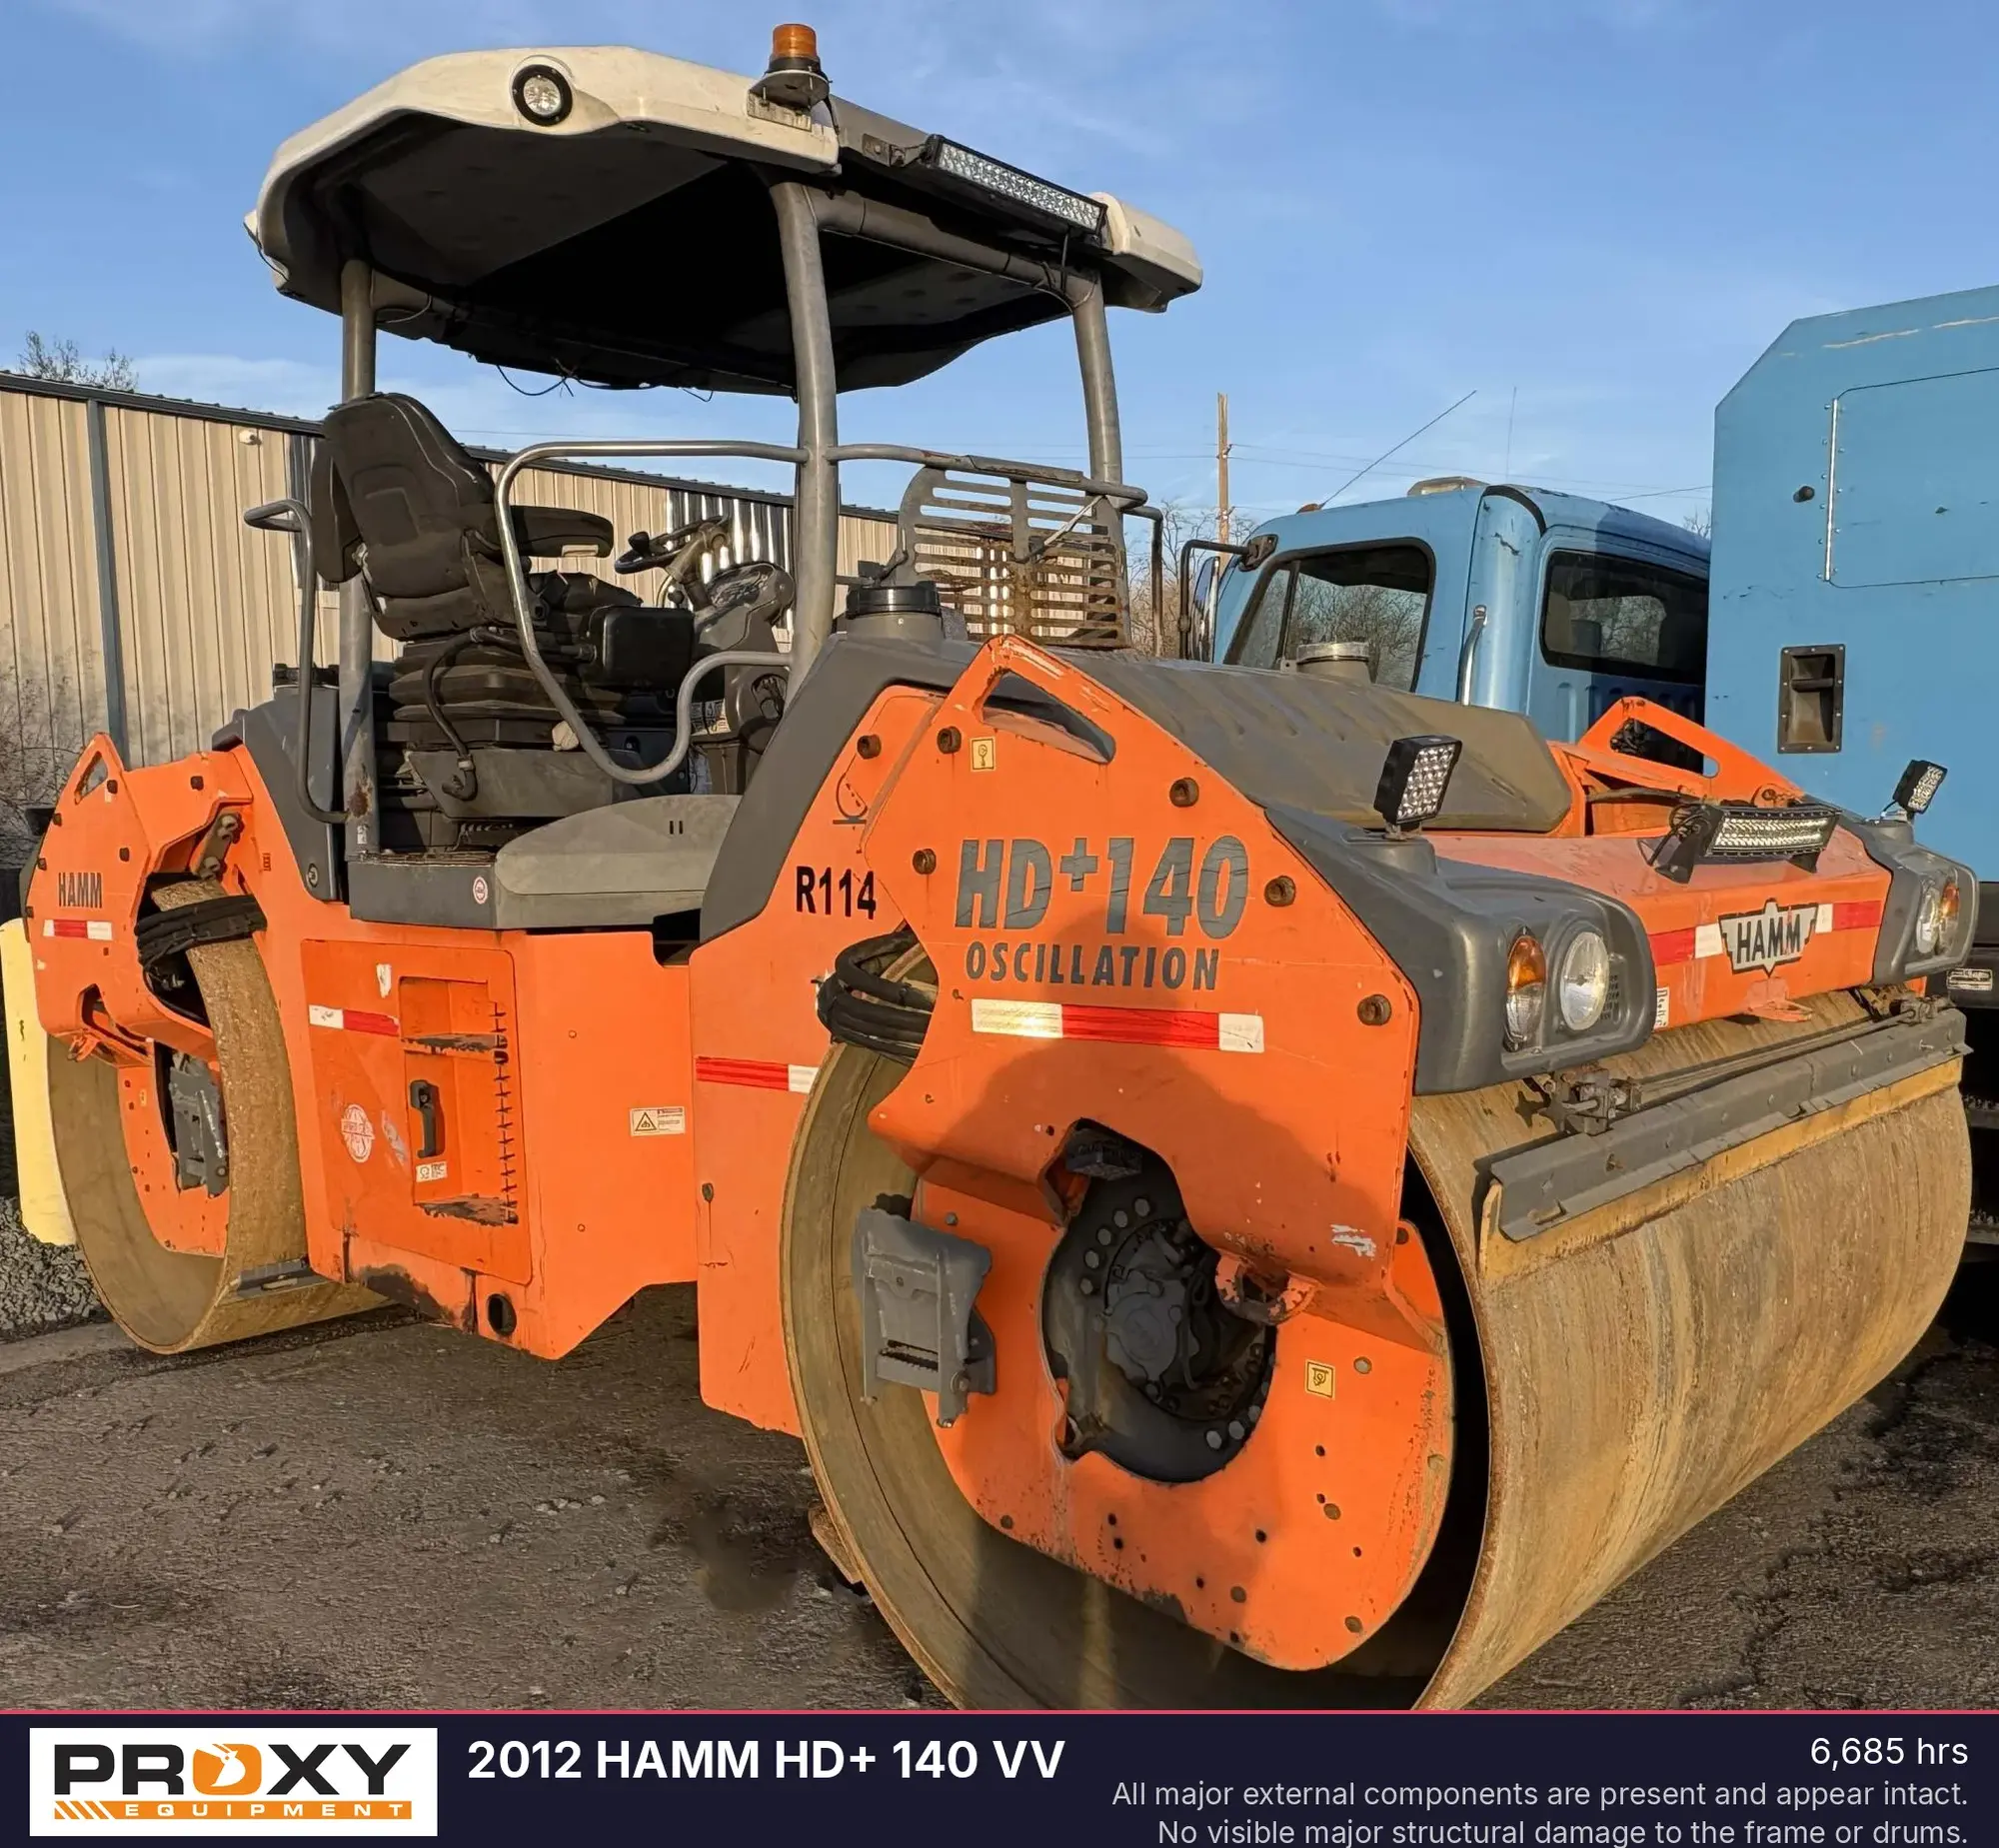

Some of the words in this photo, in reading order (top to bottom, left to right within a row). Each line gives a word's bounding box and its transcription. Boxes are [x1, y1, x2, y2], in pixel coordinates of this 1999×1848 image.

[58, 872, 103, 910] HAMM
[796, 866, 877, 921] R114
[1736, 913, 1801, 964] HAMM
[966, 940, 1219, 991] OSCILLATION
